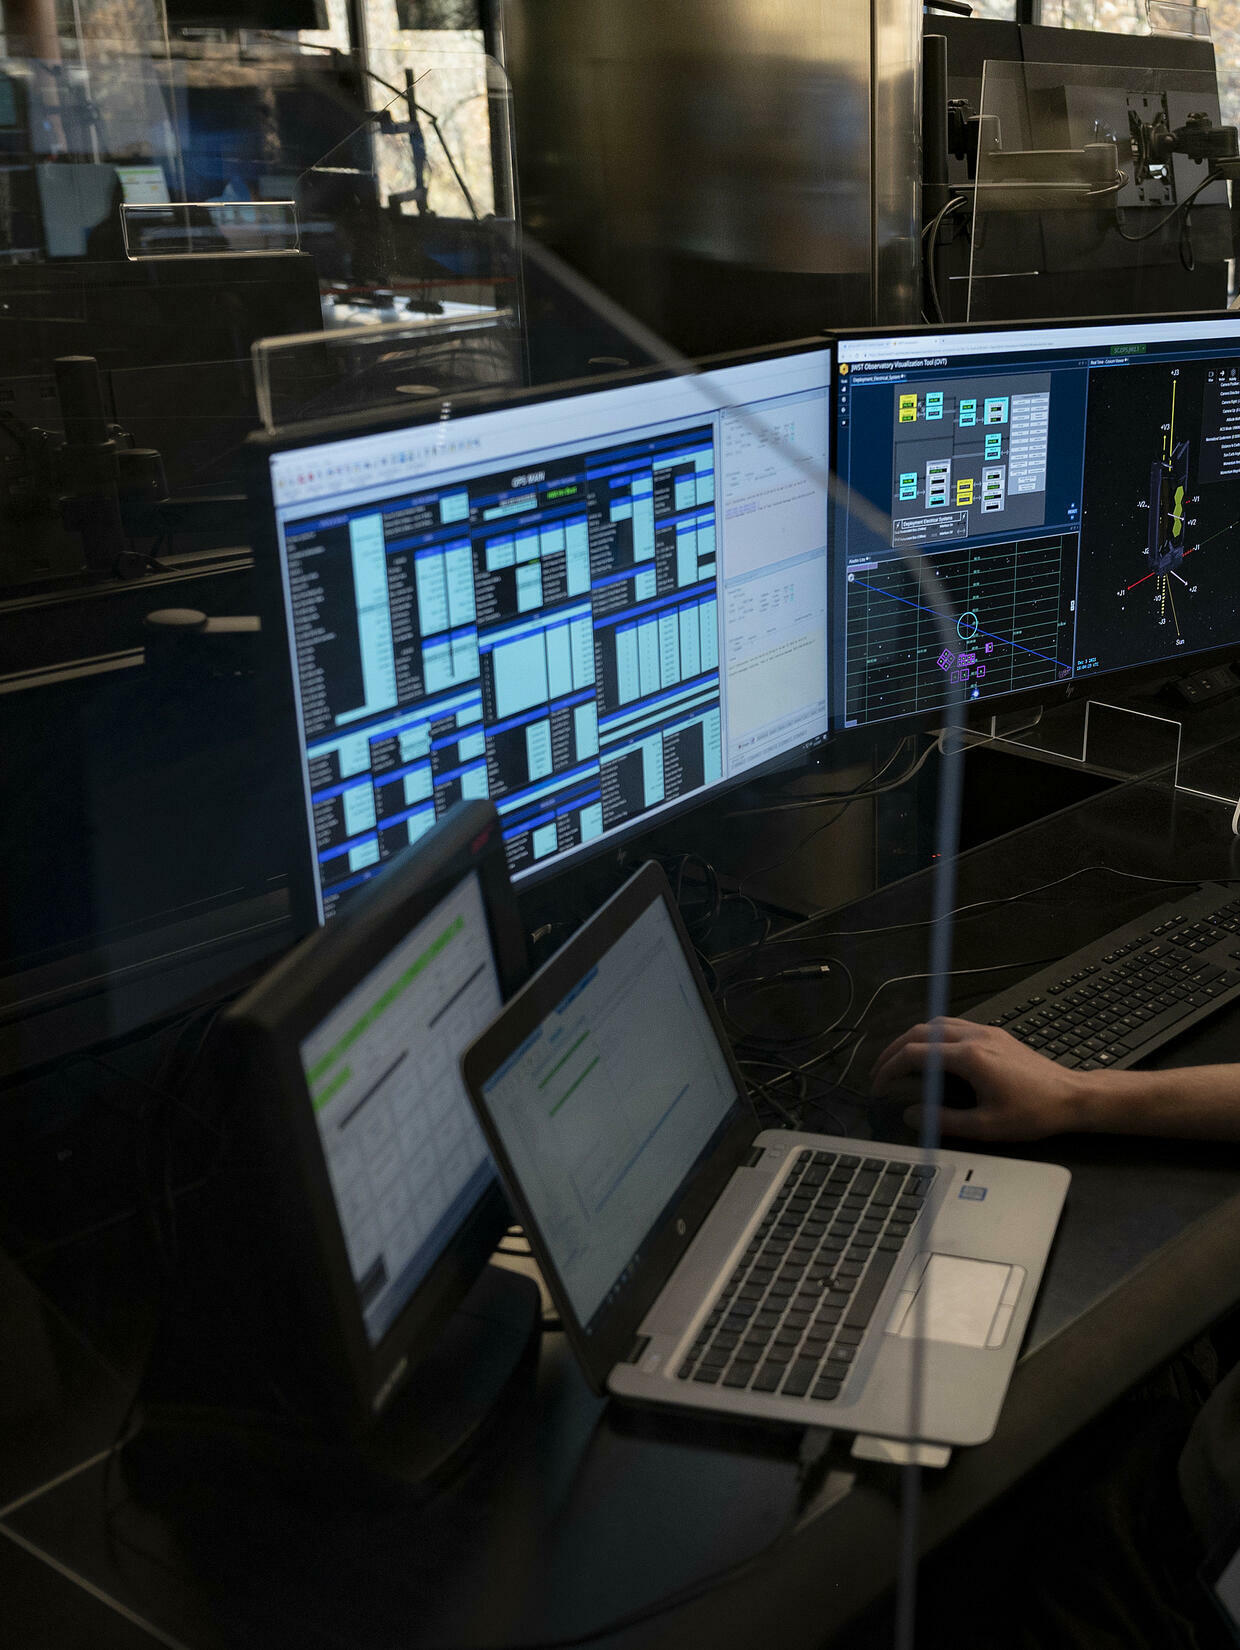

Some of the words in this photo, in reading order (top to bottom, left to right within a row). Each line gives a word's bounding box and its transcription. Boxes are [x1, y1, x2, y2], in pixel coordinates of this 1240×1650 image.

[851, 364, 864, 372] JWST
[864, 362, 894, 371] Observatory
[894, 360, 923, 369] Visualization
[925, 359, 934, 367] Tool
[935, 358, 947, 367] (OVT)
[1175, 638, 1185, 646] Sun
